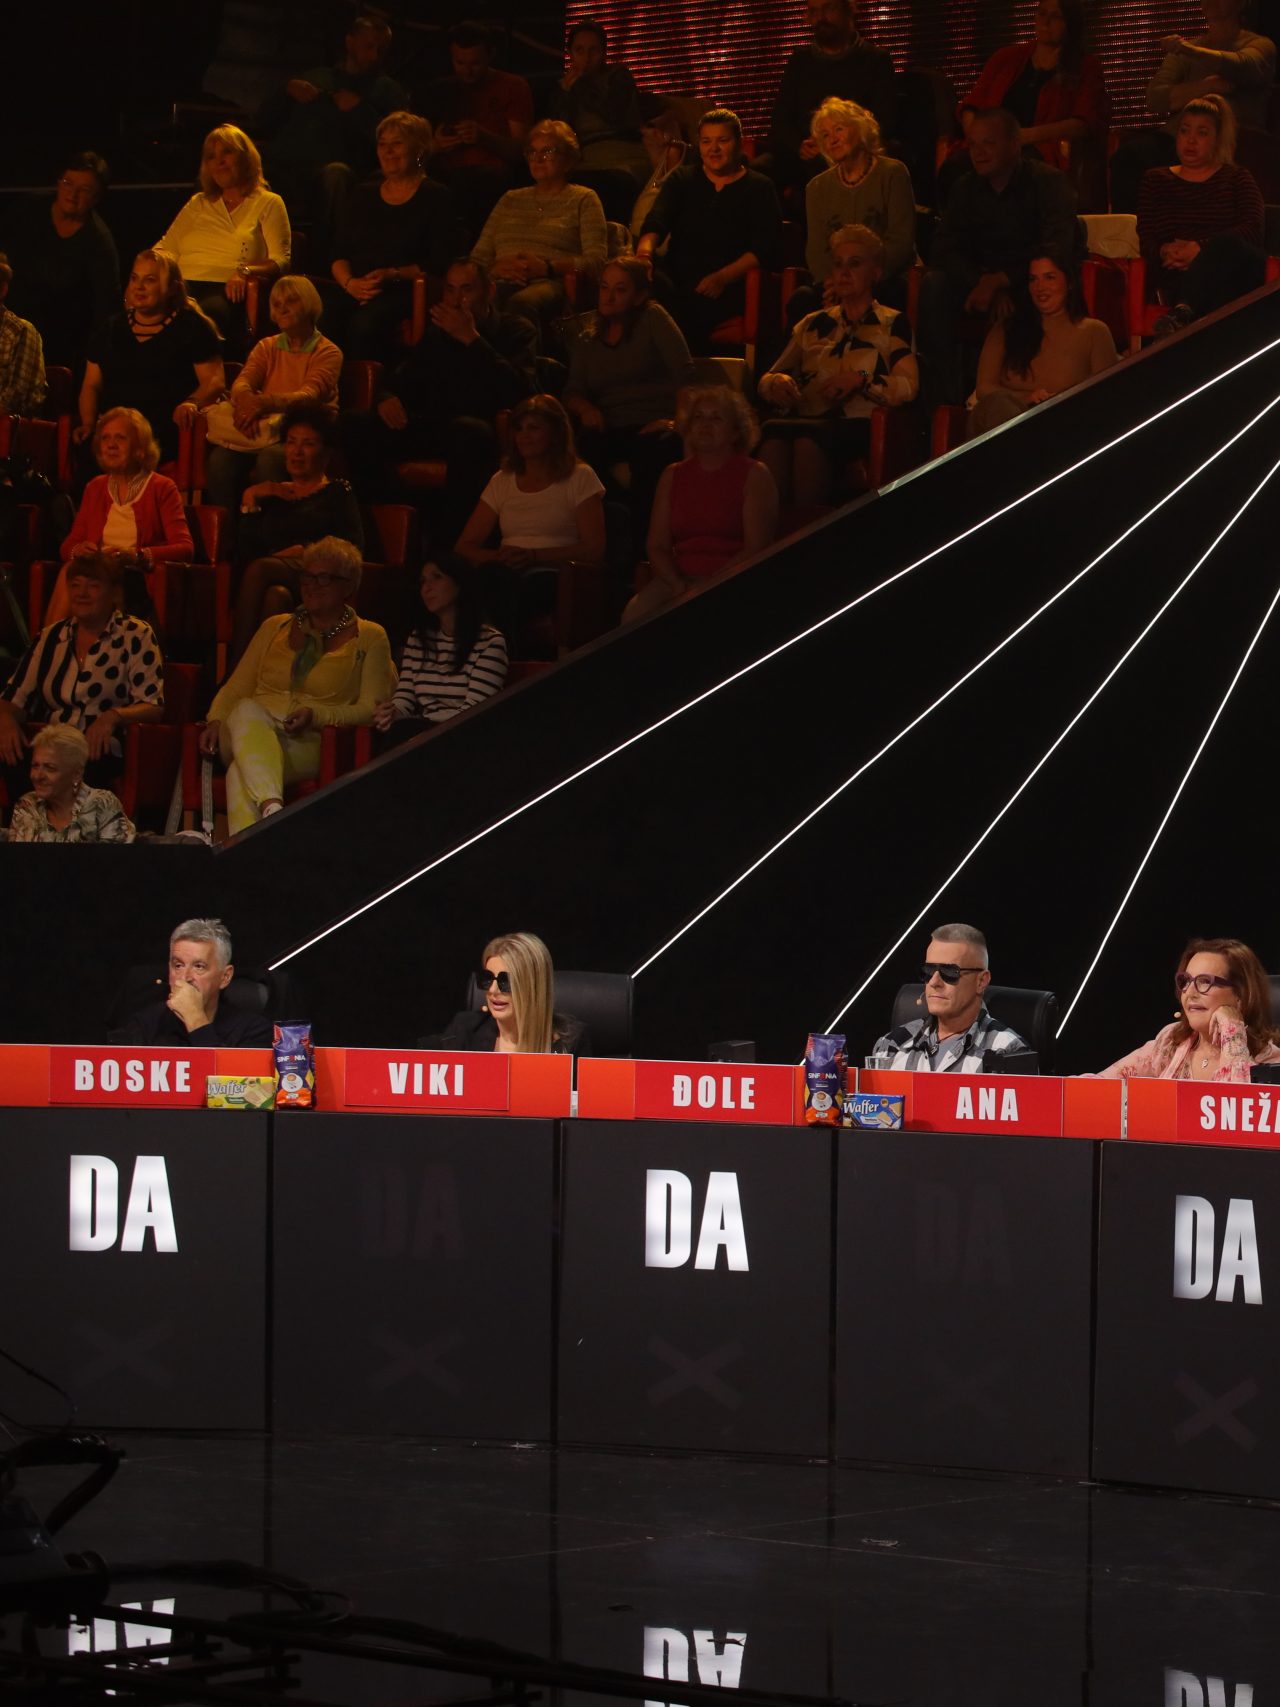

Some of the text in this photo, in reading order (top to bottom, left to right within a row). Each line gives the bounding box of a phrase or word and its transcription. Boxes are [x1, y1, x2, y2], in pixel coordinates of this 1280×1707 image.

[74, 1059, 191, 1092] BOSKE
[207, 1080, 247, 1095] Waffer
[388, 1062, 464, 1096] VIKI
[672, 1074, 755, 1109] ĐOLE
[843, 1099, 879, 1114] Waffer
[955, 1086, 1019, 1122] ANA
[69, 1154, 179, 1253] DA
[644, 1168, 750, 1272] DA
[1173, 1194, 1263, 1305] DA
